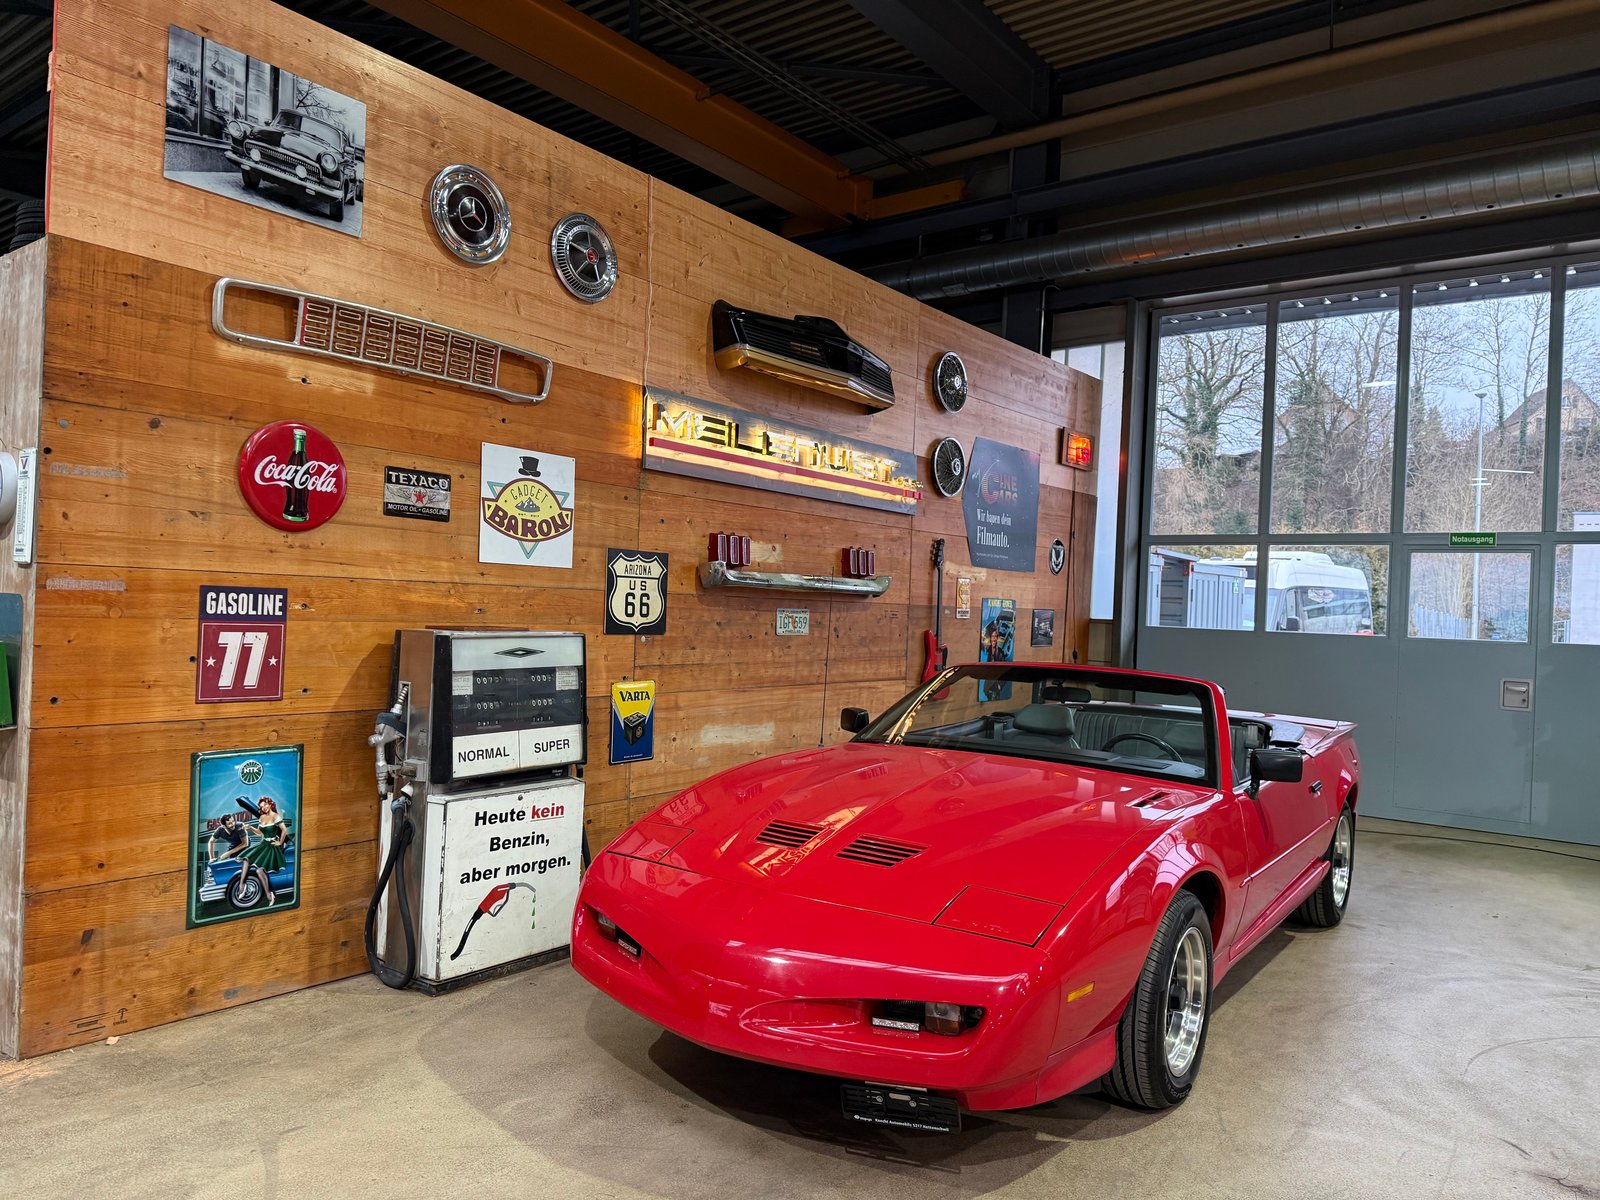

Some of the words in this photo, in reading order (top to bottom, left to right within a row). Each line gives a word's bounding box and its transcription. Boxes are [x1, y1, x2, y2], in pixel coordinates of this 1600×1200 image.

[254, 455, 339, 492] Coca-Cola
[389, 471, 449, 490] TEXACO
[510, 484, 548, 503] GADGET
[387, 503, 408, 511] MOTOR
[421, 507, 448, 516] GASOLINE
[977, 509, 986, 522] Wir
[1001, 512, 1012, 526] dein
[488, 504, 569, 538] BARON
[976, 526, 1010, 548] Filmauto.
[1452, 536, 1494, 544] Notausgang
[624, 564, 652, 576] ARIZONA
[205, 591, 283, 616] GASOLINE
[625, 592, 650, 618] 66
[217, 631, 269, 690] 77
[619, 690, 650, 702] VARTA
[458, 746, 510, 763] NORMAL
[534, 739, 570, 753] SUPER
[474, 808, 526, 826] Heute
[531, 803, 565, 820] kein
[489, 832, 550, 852] Benzin,
[460, 868, 501, 884] aber
[504, 855, 571, 876] morgen.
